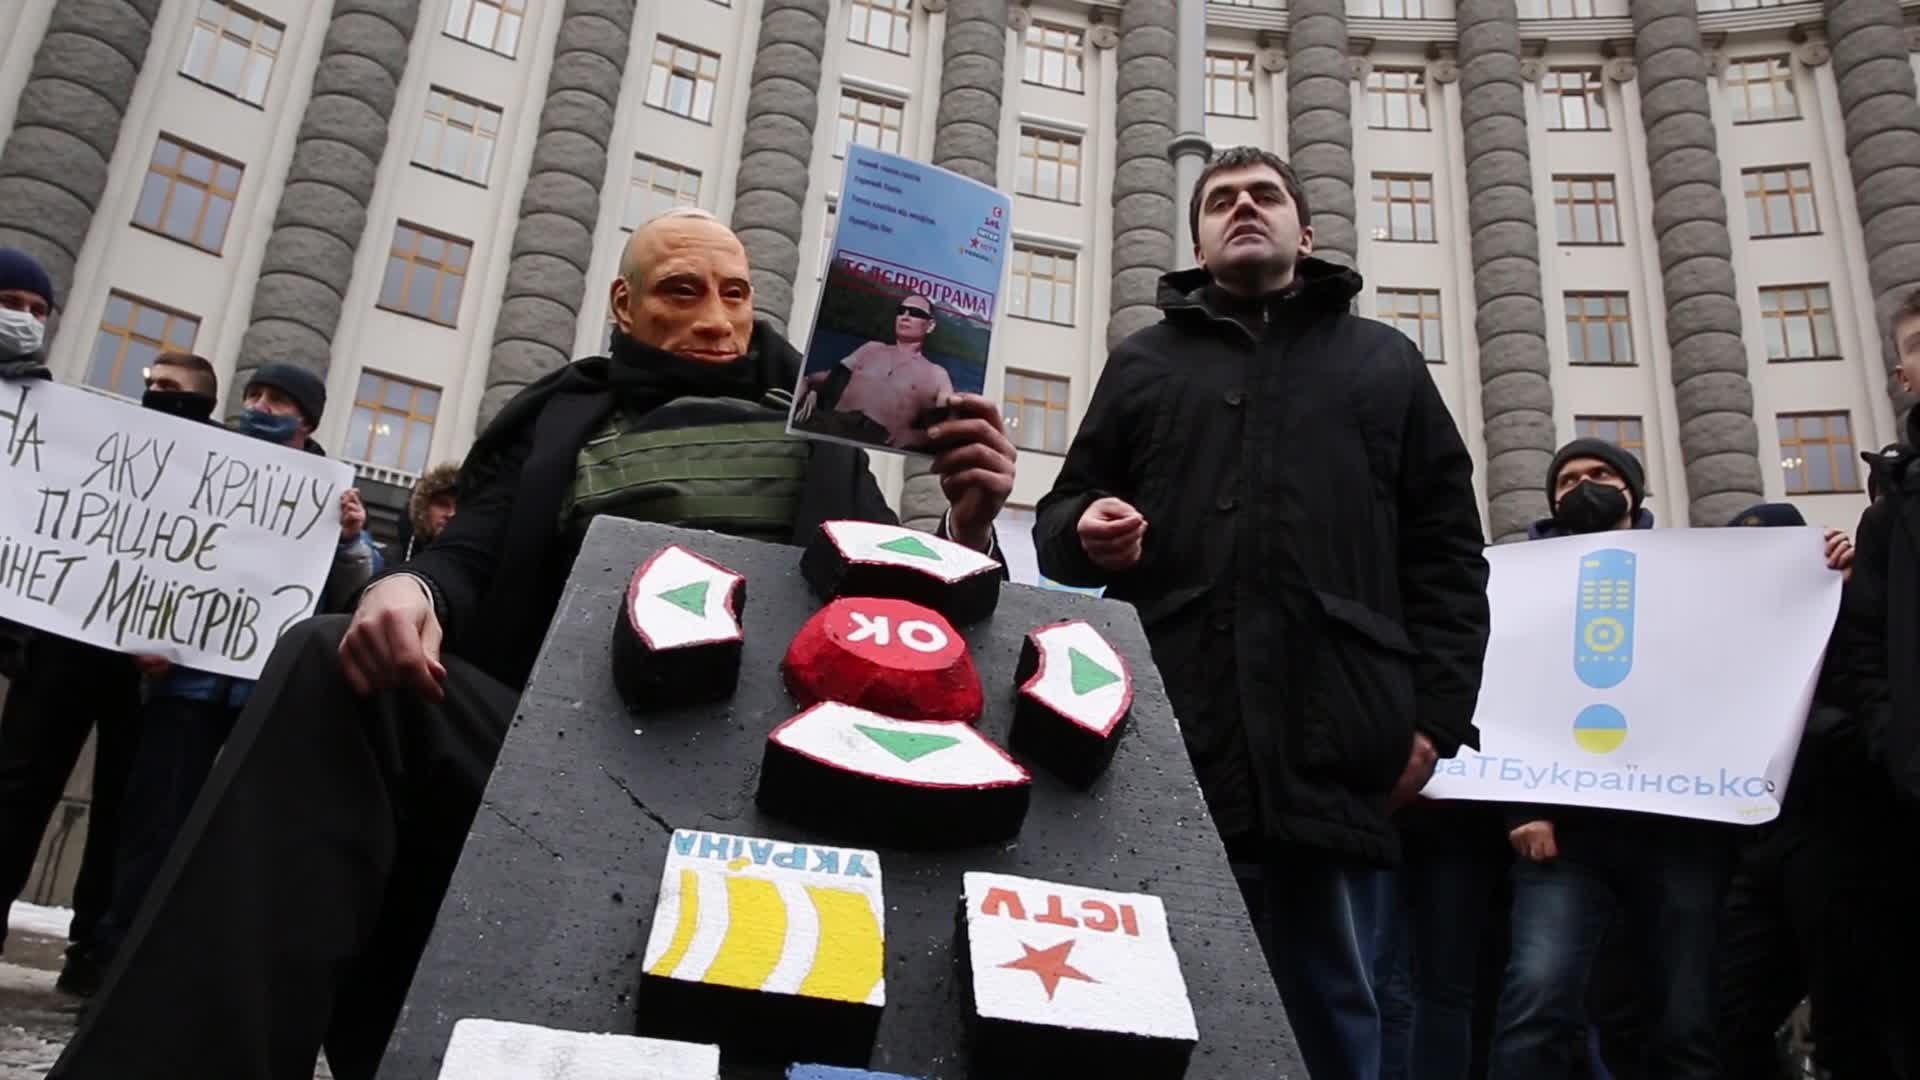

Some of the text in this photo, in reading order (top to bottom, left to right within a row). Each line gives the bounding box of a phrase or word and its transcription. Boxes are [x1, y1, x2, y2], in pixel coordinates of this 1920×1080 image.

[81, 432, 176, 501] ЯКУ
[189, 451, 335, 540] КРАЇНУ
[34, 488, 228, 571] ПРАЦЮЄ
[0, 536, 87, 606] ІНЕТ
[674, 831, 874, 879] УКРАЇНА
[980, 887, 1140, 937] ICTV
